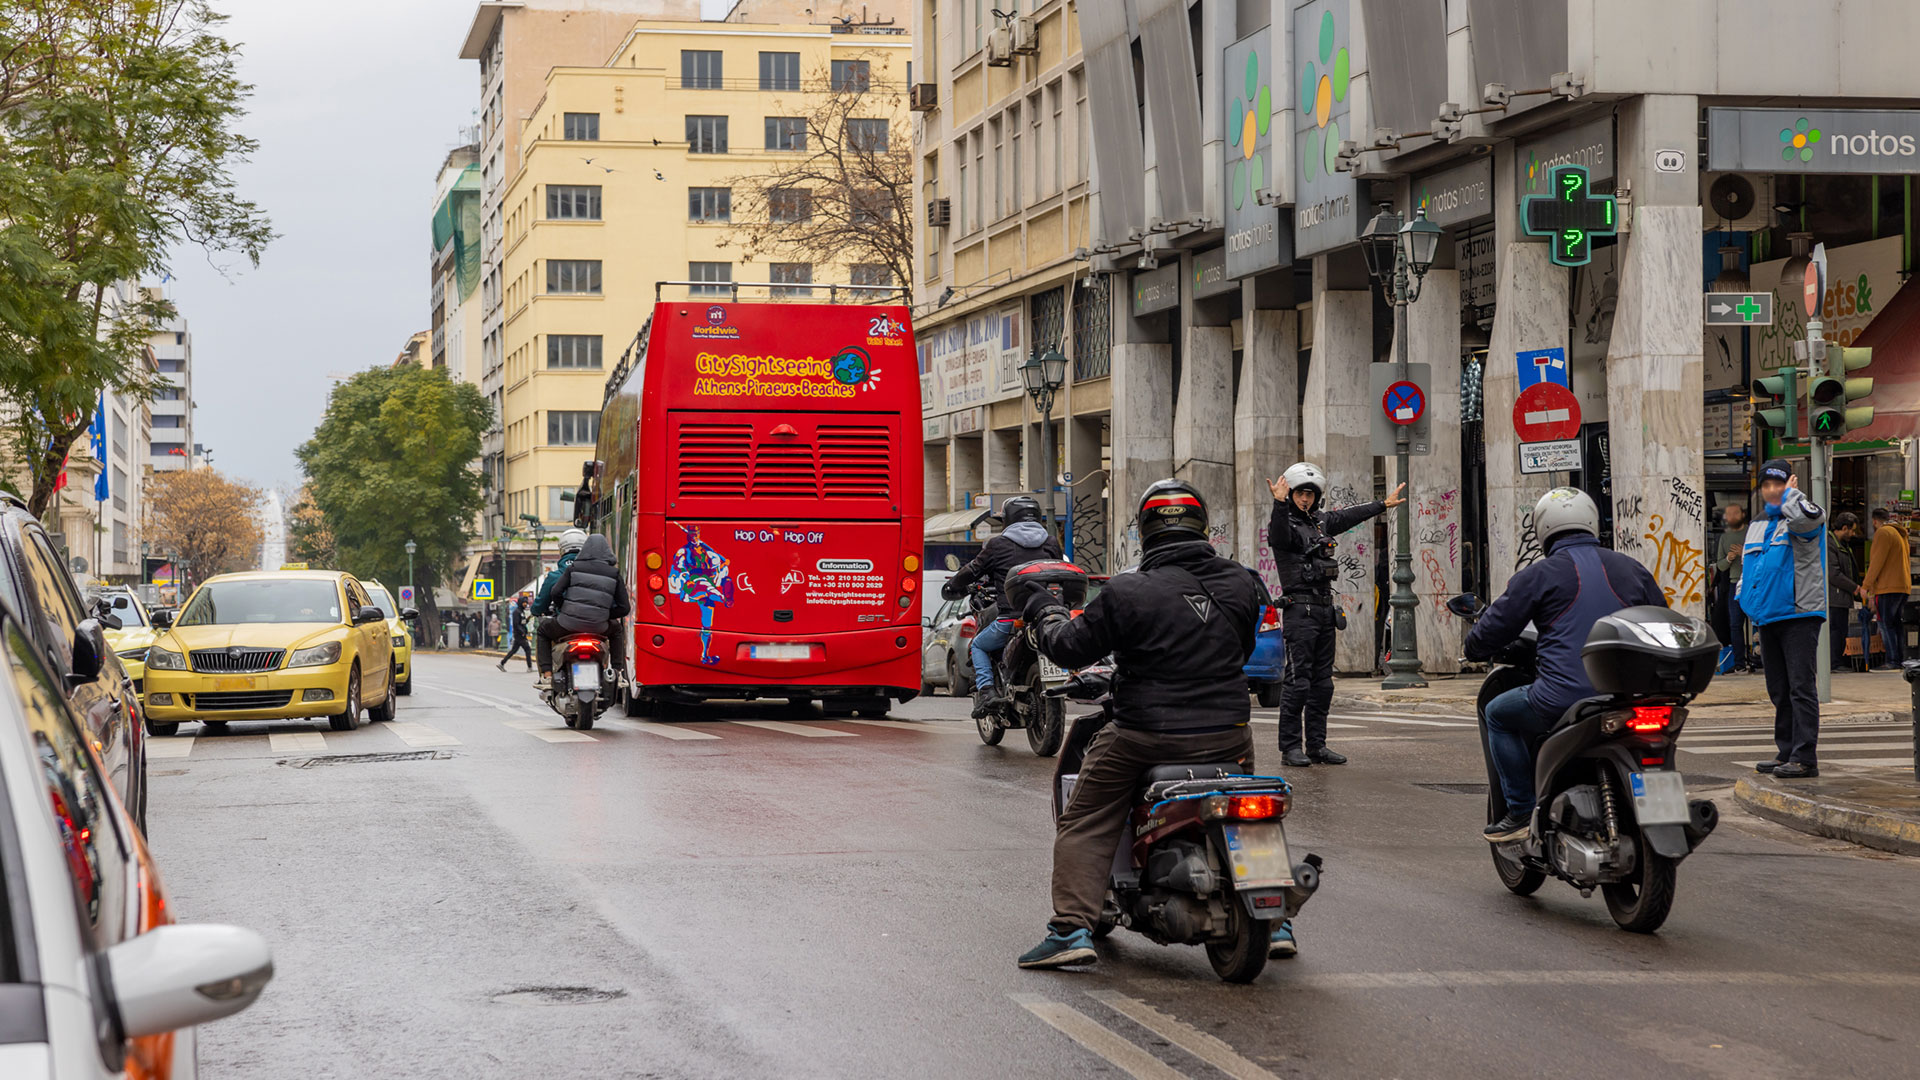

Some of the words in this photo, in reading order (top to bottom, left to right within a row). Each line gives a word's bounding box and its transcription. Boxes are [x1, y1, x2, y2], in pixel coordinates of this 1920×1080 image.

[1832, 130, 1916, 156] notos
[1432, 189, 1458, 213] notos
[1458, 180, 1485, 207] home
[1300, 203, 1324, 230] notos
[1325, 194, 1349, 220] home
[1229, 227, 1251, 253] notos
[1251, 221, 1273, 245] home
[693, 325, 739, 335] Worldwide
[868, 317, 889, 337] 24
[984, 312, 1000, 342] ZOO
[735, 529, 756, 542] Hop
[759, 530, 774, 542] On
[784, 530, 805, 543] Hop
[807, 531, 824, 544] Off
[805, 591, 886, 599] www.citysightseeing.gr
